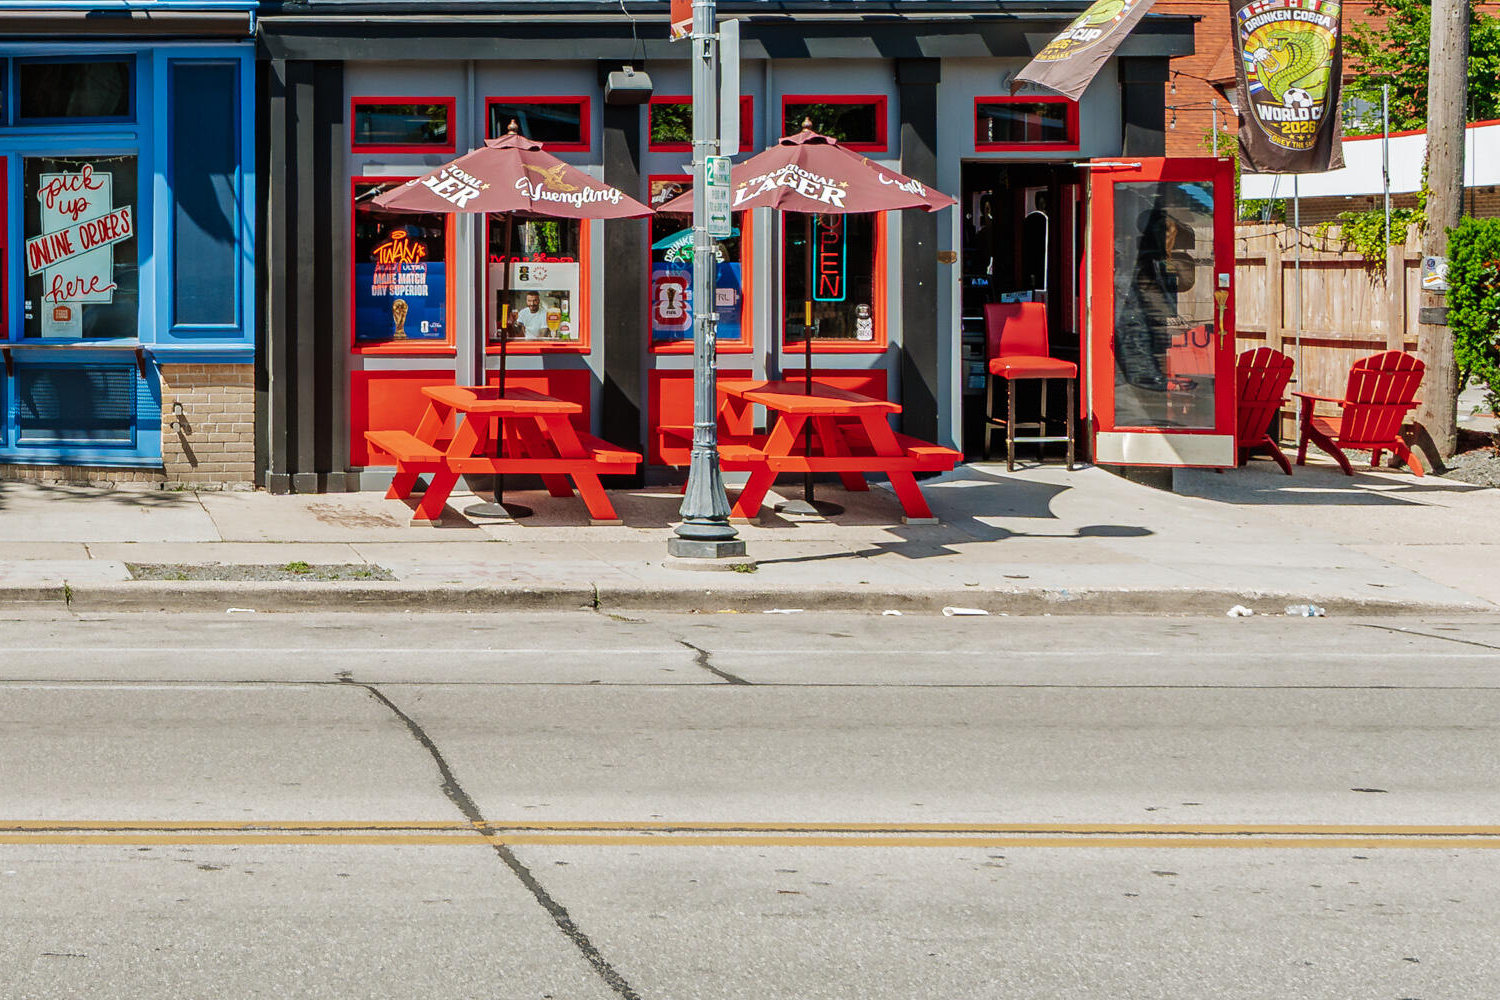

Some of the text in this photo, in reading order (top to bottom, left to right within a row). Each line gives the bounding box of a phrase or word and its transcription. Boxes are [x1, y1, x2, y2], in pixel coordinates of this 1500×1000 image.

[1244, 9, 1331, 33] DRUNKEN COBRA
[1071, 28, 1103, 42] CUP
[1256, 103, 1309, 122] WORLD
[1281, 120, 1317, 134] 2026
[1271, 135, 1291, 148] OBEY
[1292, 140, 1305, 149] THE
[707, 162, 714, 182] 2
[38, 165, 104, 209] pick
[732, 170, 847, 208] LAGER
[58, 197, 92, 222] up
[28, 208, 131, 271] ONLINE ORDERS
[664, 236, 695, 263] DRUNKE
[819, 212, 842, 297] OPEN
[44, 274, 117, 304] here
[371, 284, 429, 297] DAY SUPERIOR
[398, 272, 426, 285] MATCH
